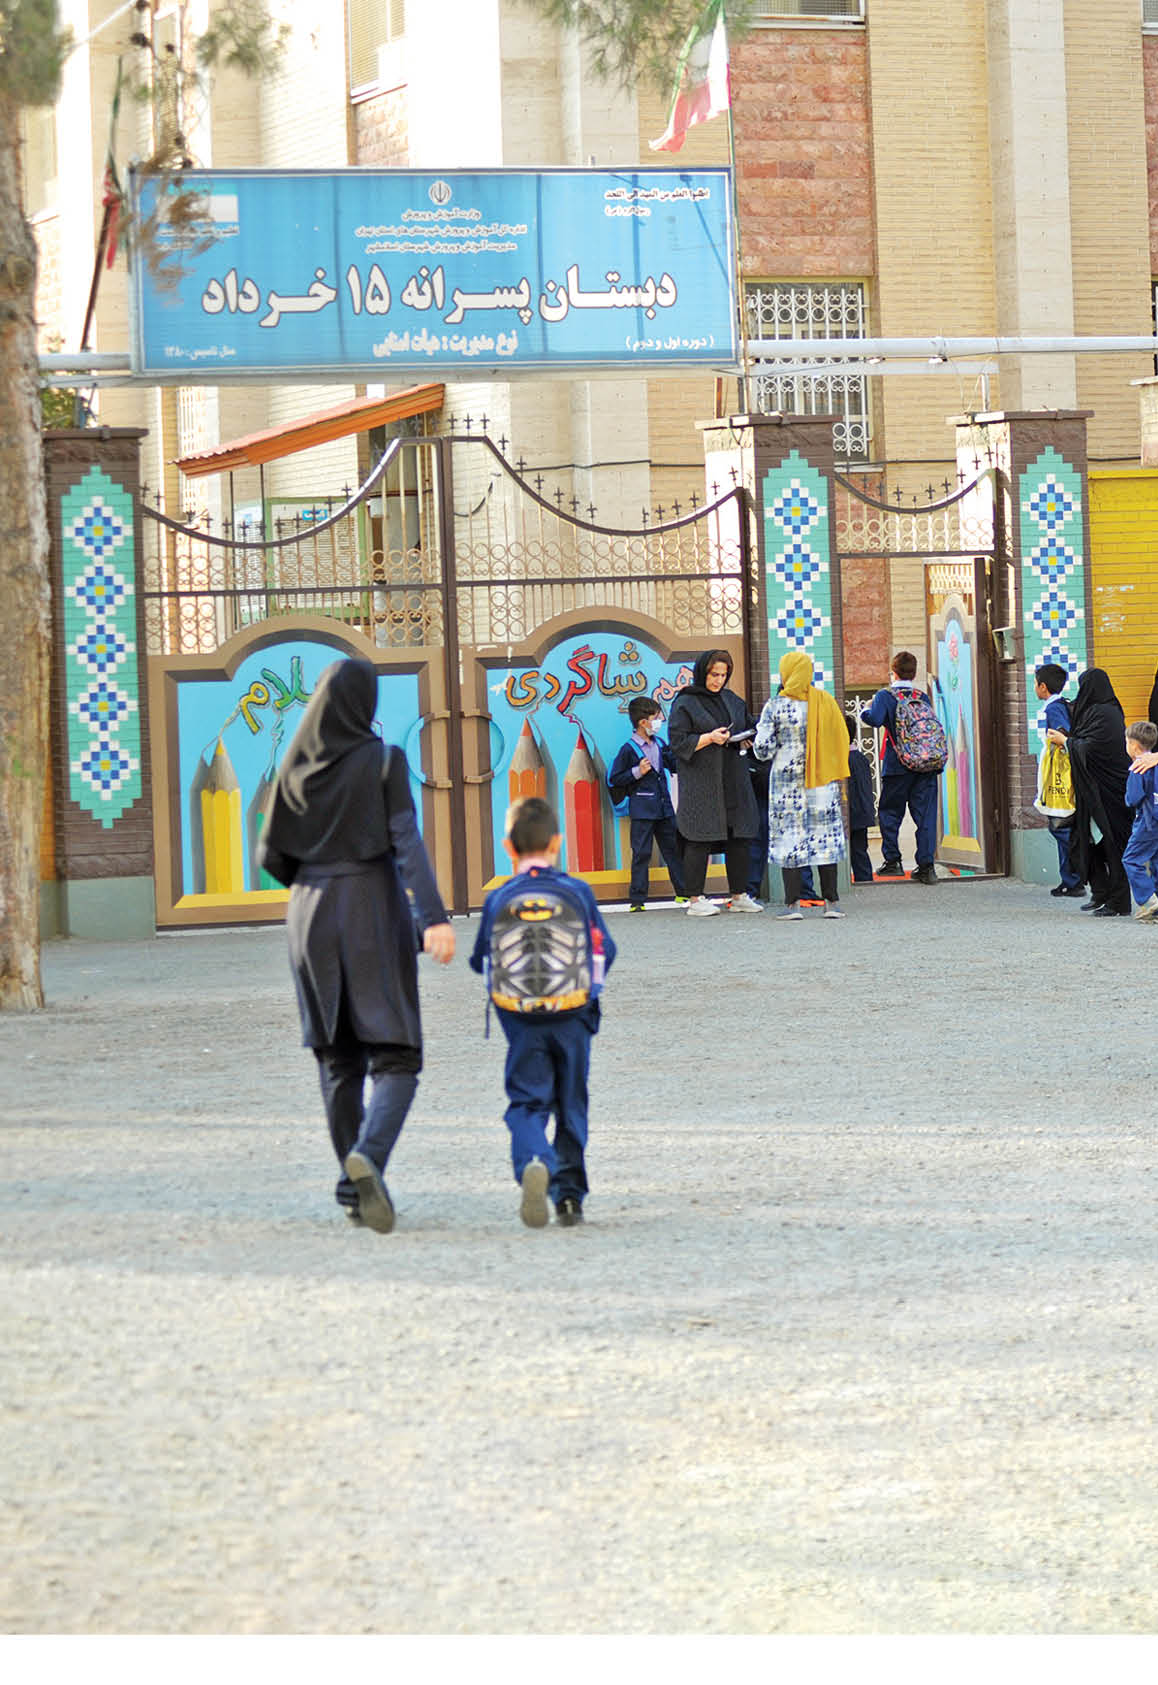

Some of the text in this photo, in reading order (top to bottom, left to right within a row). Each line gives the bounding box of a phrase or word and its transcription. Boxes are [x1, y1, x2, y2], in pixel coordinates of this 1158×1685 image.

[671, 188, 688, 201] العلم
[402, 208, 428, 221] پرورش
[434, 207, 458, 221] آموزش
[458, 208, 481, 221] وزارت
[441, 225, 466, 237] پرورش
[473, 223, 497, 236] آموزش
[430, 241, 456, 253] پرورش
[462, 240, 488, 253] آموزش
[201, 263, 678, 328] دبستان پسرانه ۱۵ خرداد
[495, 329, 519, 356] نوع
[506, 641, 648, 713] شاگردی
[240, 655, 314, 736] لام
